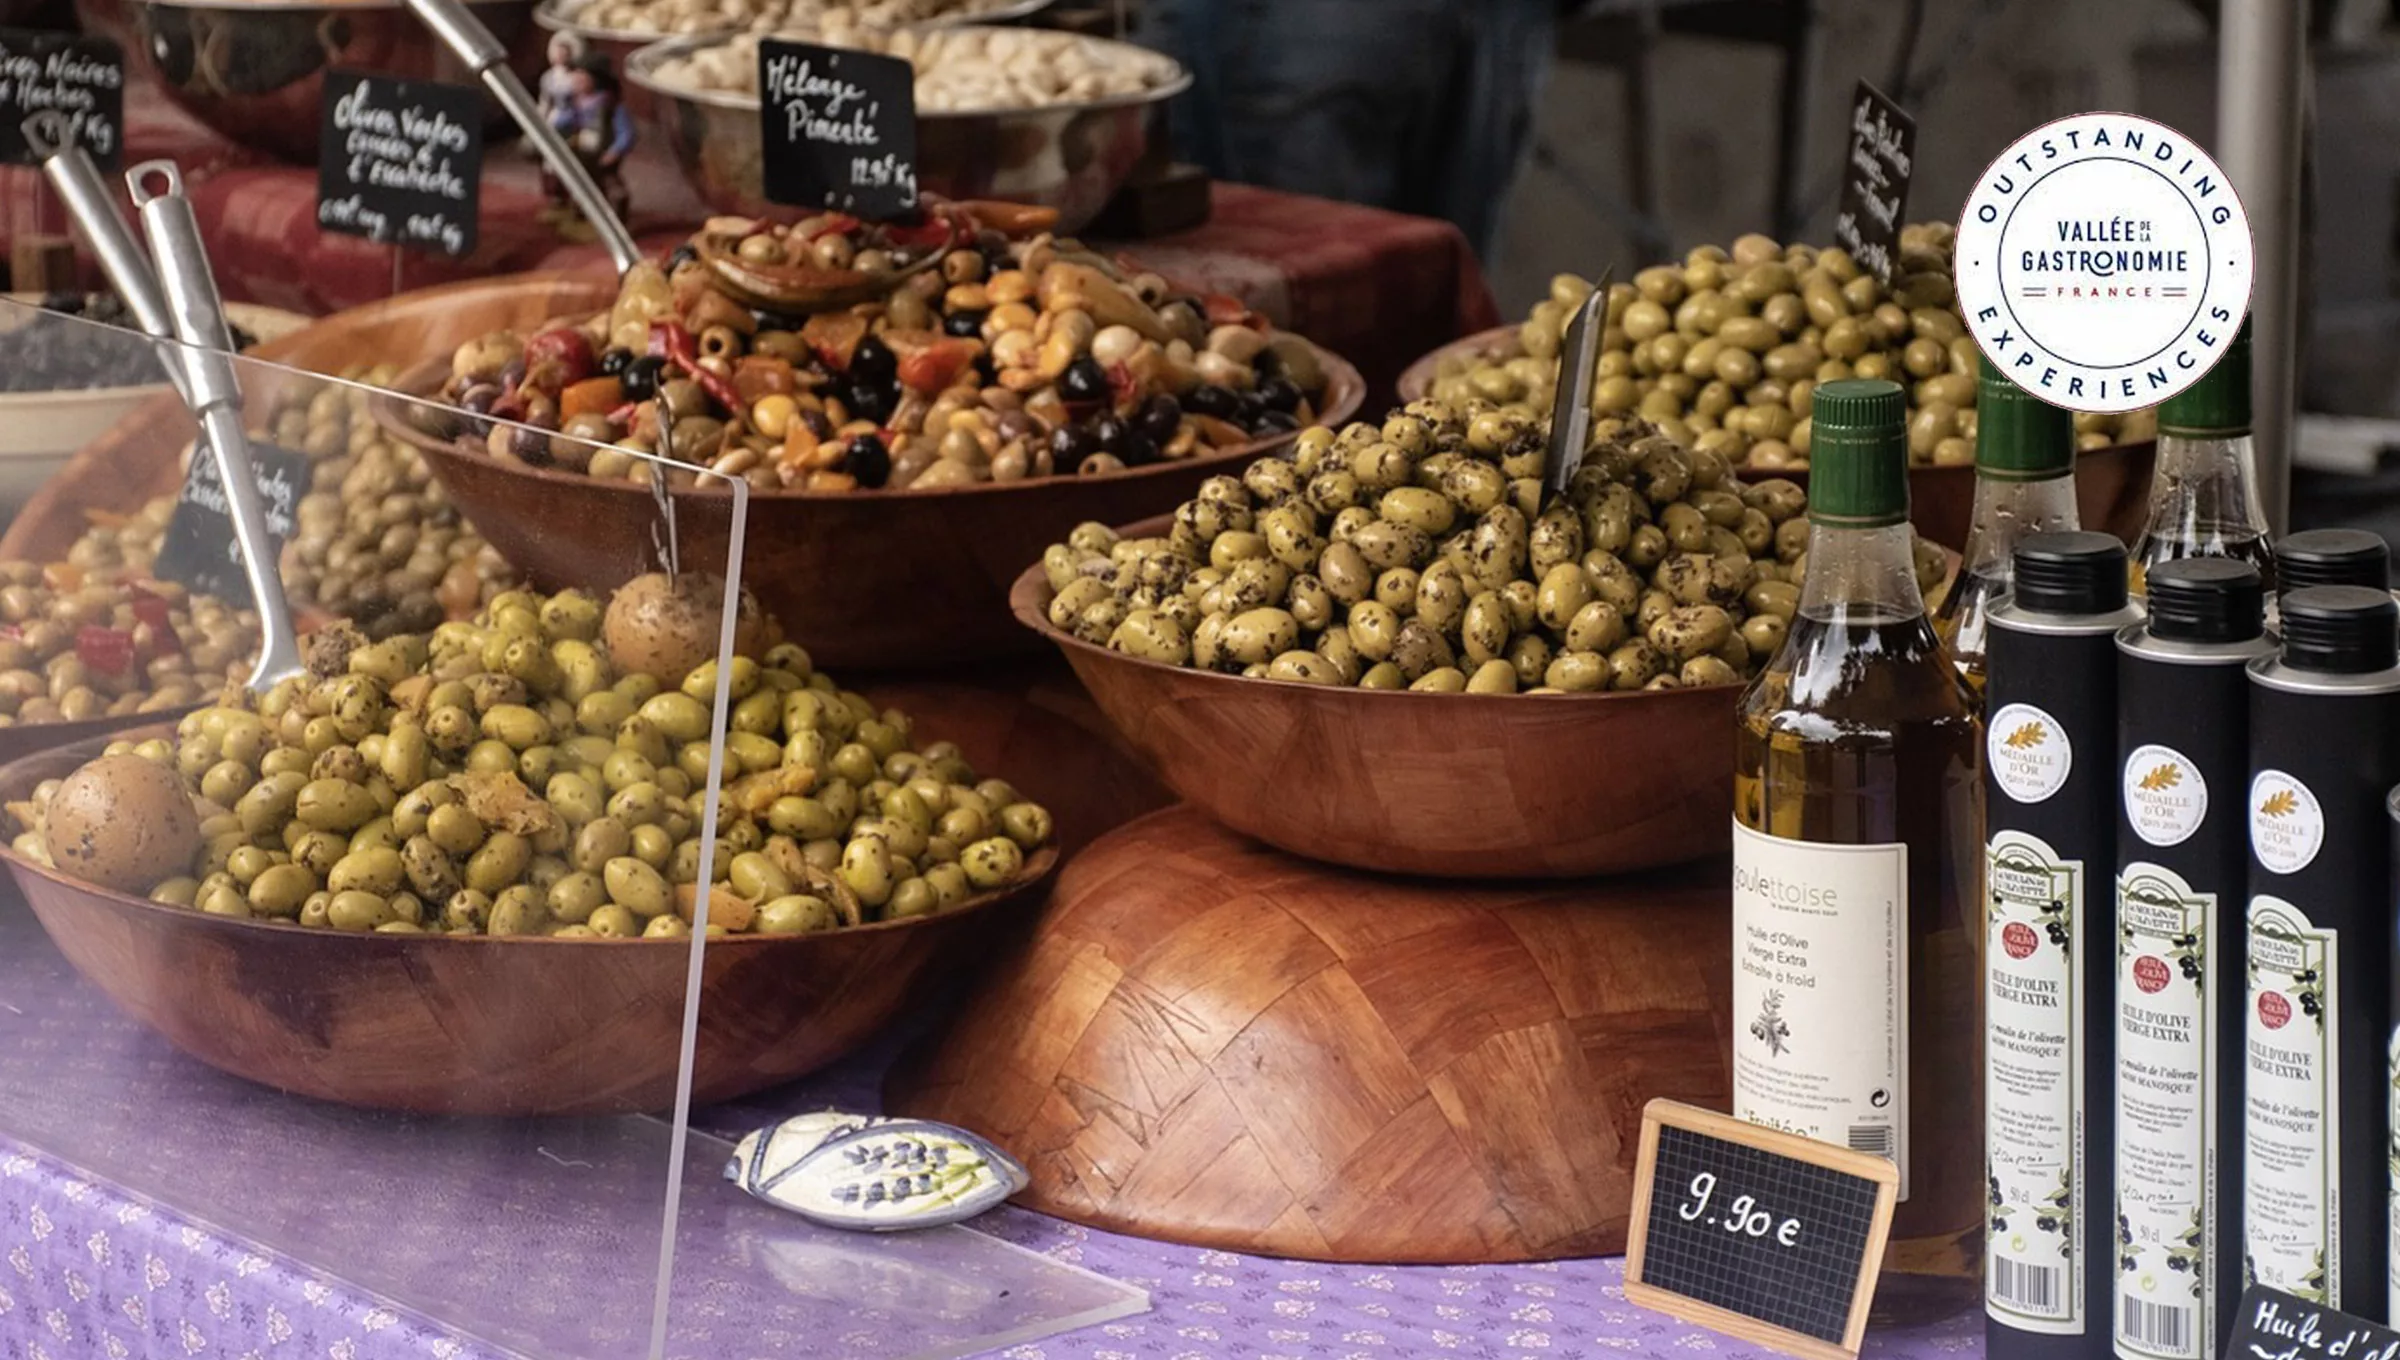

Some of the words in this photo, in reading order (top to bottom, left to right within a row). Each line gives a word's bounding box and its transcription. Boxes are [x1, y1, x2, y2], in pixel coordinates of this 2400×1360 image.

[767, 54, 866, 117] Mélange
[1776, 950, 1807, 968] Extra
[1786, 972, 1816, 989] froid
[2014, 976, 2059, 994] D'OLIVE
[2021, 991, 2058, 1008] EXTRA
[2145, 1010, 2191, 1029] D'OLIVE
[2152, 1026, 2190, 1043] EXTRA
[2138, 1077, 2193, 1095] MANOSQUE
[1678, 1172, 1801, 1247] 9.90€
[2254, 1301, 2322, 1348] Huile
